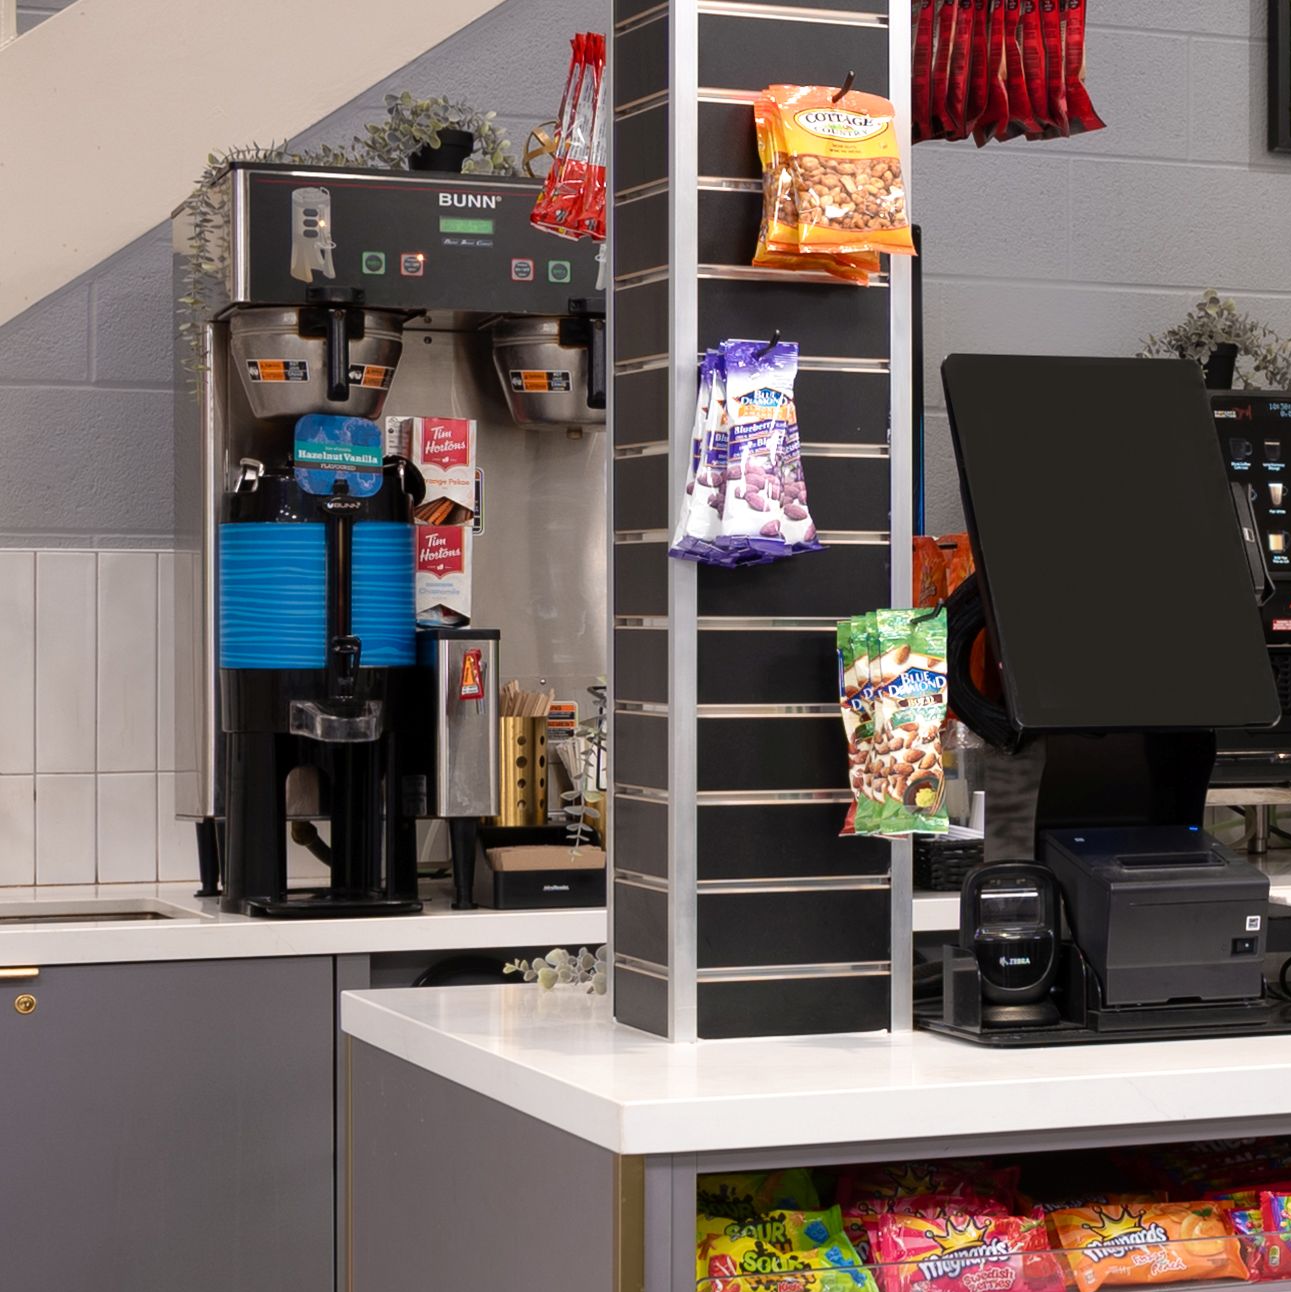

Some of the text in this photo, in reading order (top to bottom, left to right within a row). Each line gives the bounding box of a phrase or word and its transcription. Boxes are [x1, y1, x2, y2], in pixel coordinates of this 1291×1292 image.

[805, 112, 873, 127] COTTAGE
[813, 125, 869, 137] COUNTRY
[438, 192, 496, 209] BUNN
[431, 425, 452, 440] Tim
[425, 438, 466, 454] Hortons
[298, 449, 343, 462] Hazelnut
[343, 452, 378, 464] Vanilla
[448, 478, 470, 486] Pekoe
[425, 534, 446, 548] Tim
[419, 546, 460, 562] Hortons
[888, 673, 946, 698] DIAMOND
[900, 671, 930, 686] BLUE
[725, 1218, 787, 1242] SOUR
[1083, 1223, 1168, 1263] Maynards
[918, 1238, 1011, 1281] Maynards
[1151, 1258, 1187, 1276] Peach
[962, 1266, 1016, 1286] Swedish
